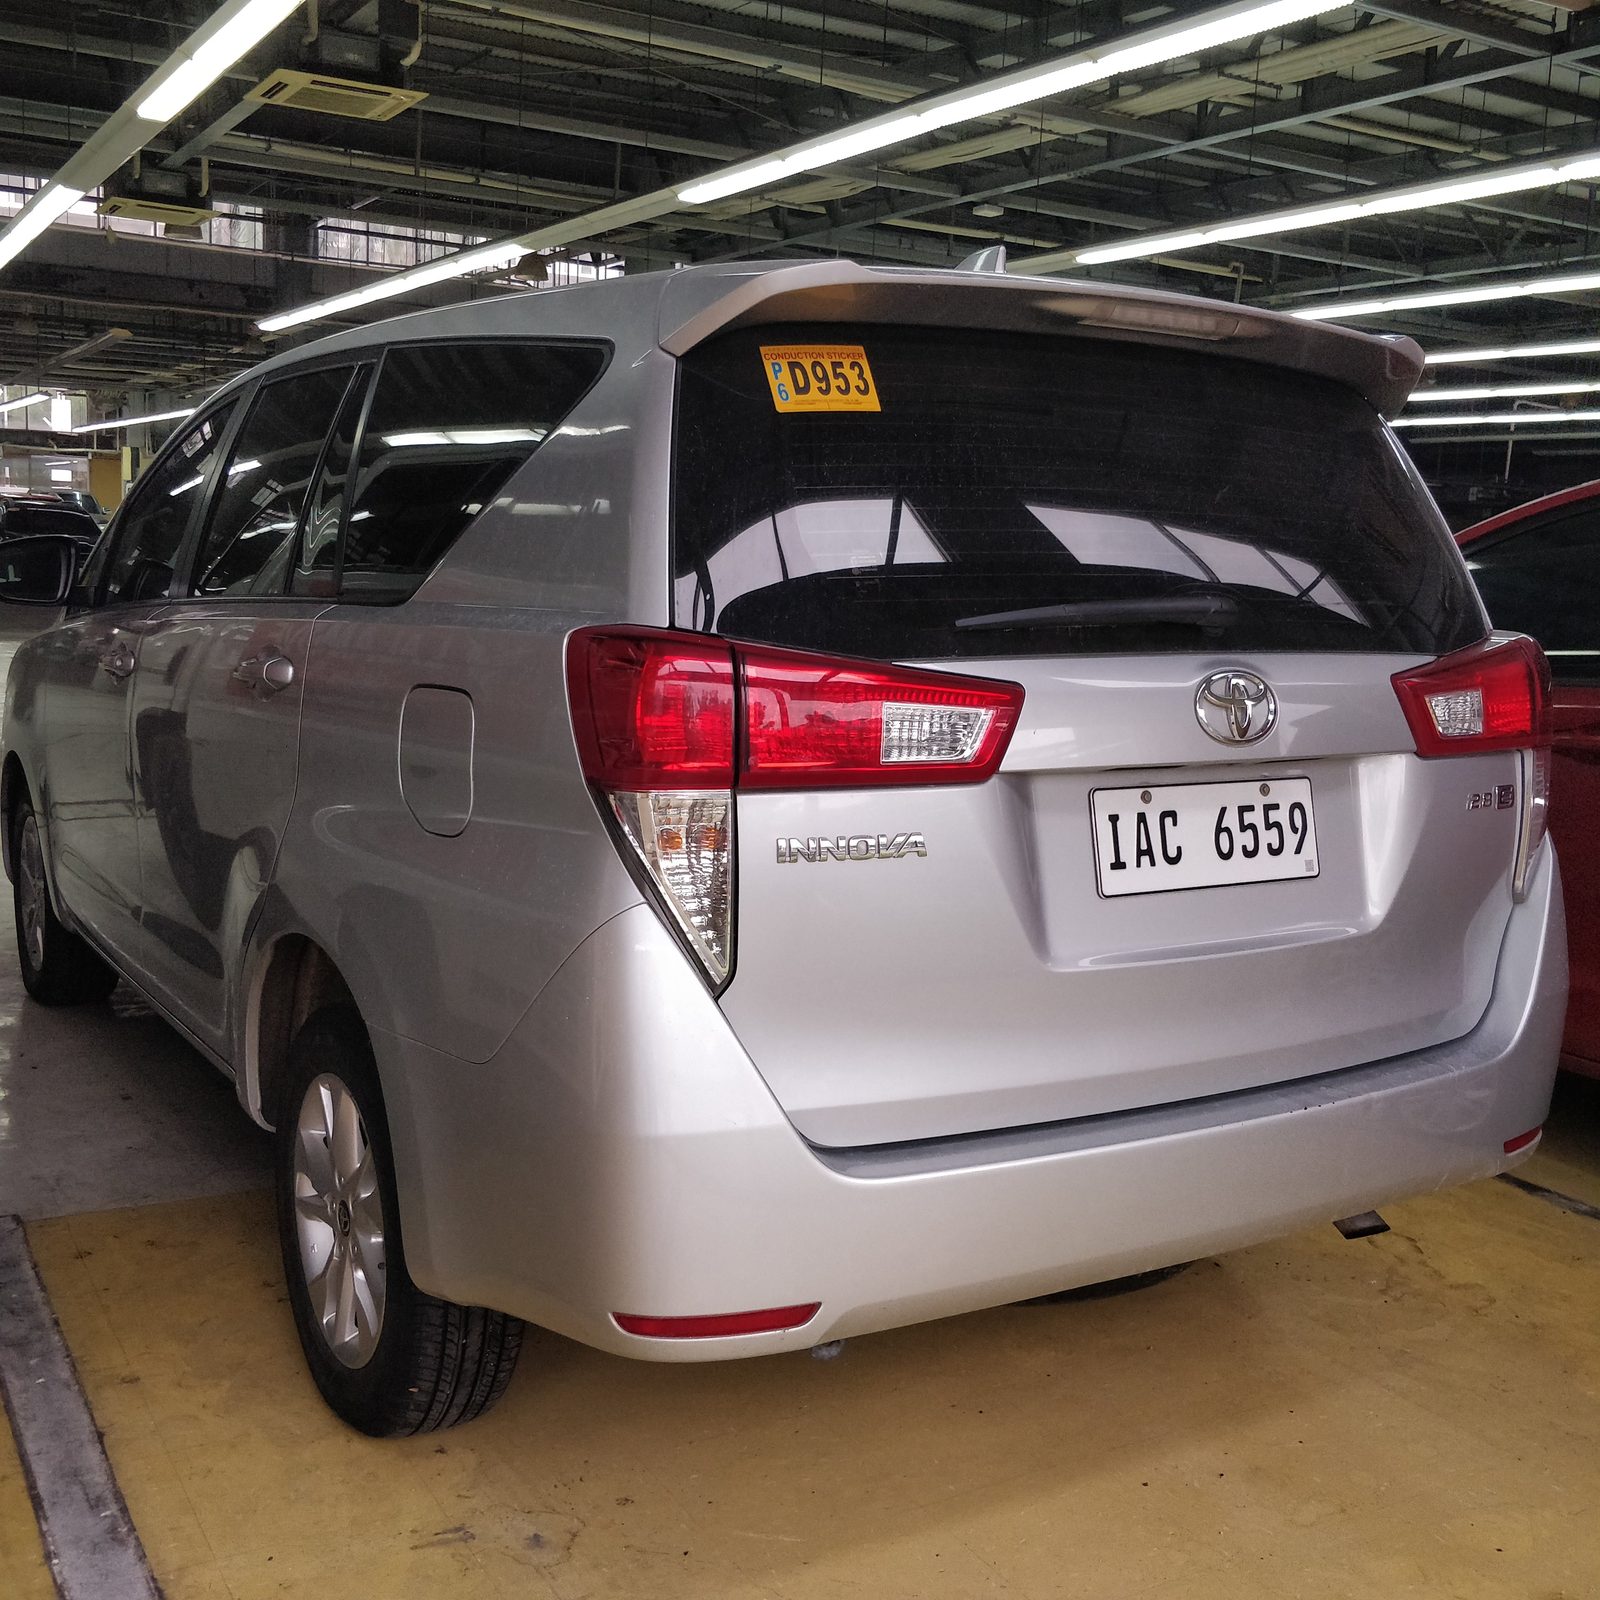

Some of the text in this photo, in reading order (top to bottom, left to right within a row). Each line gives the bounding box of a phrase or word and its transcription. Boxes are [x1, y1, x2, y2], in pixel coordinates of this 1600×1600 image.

[764, 351, 864, 360] CONDUCTION STICKER
[787, 361, 870, 396] D953
[776, 831, 928, 864] INNOVA
[1108, 802, 1308, 870] IAC 6559
